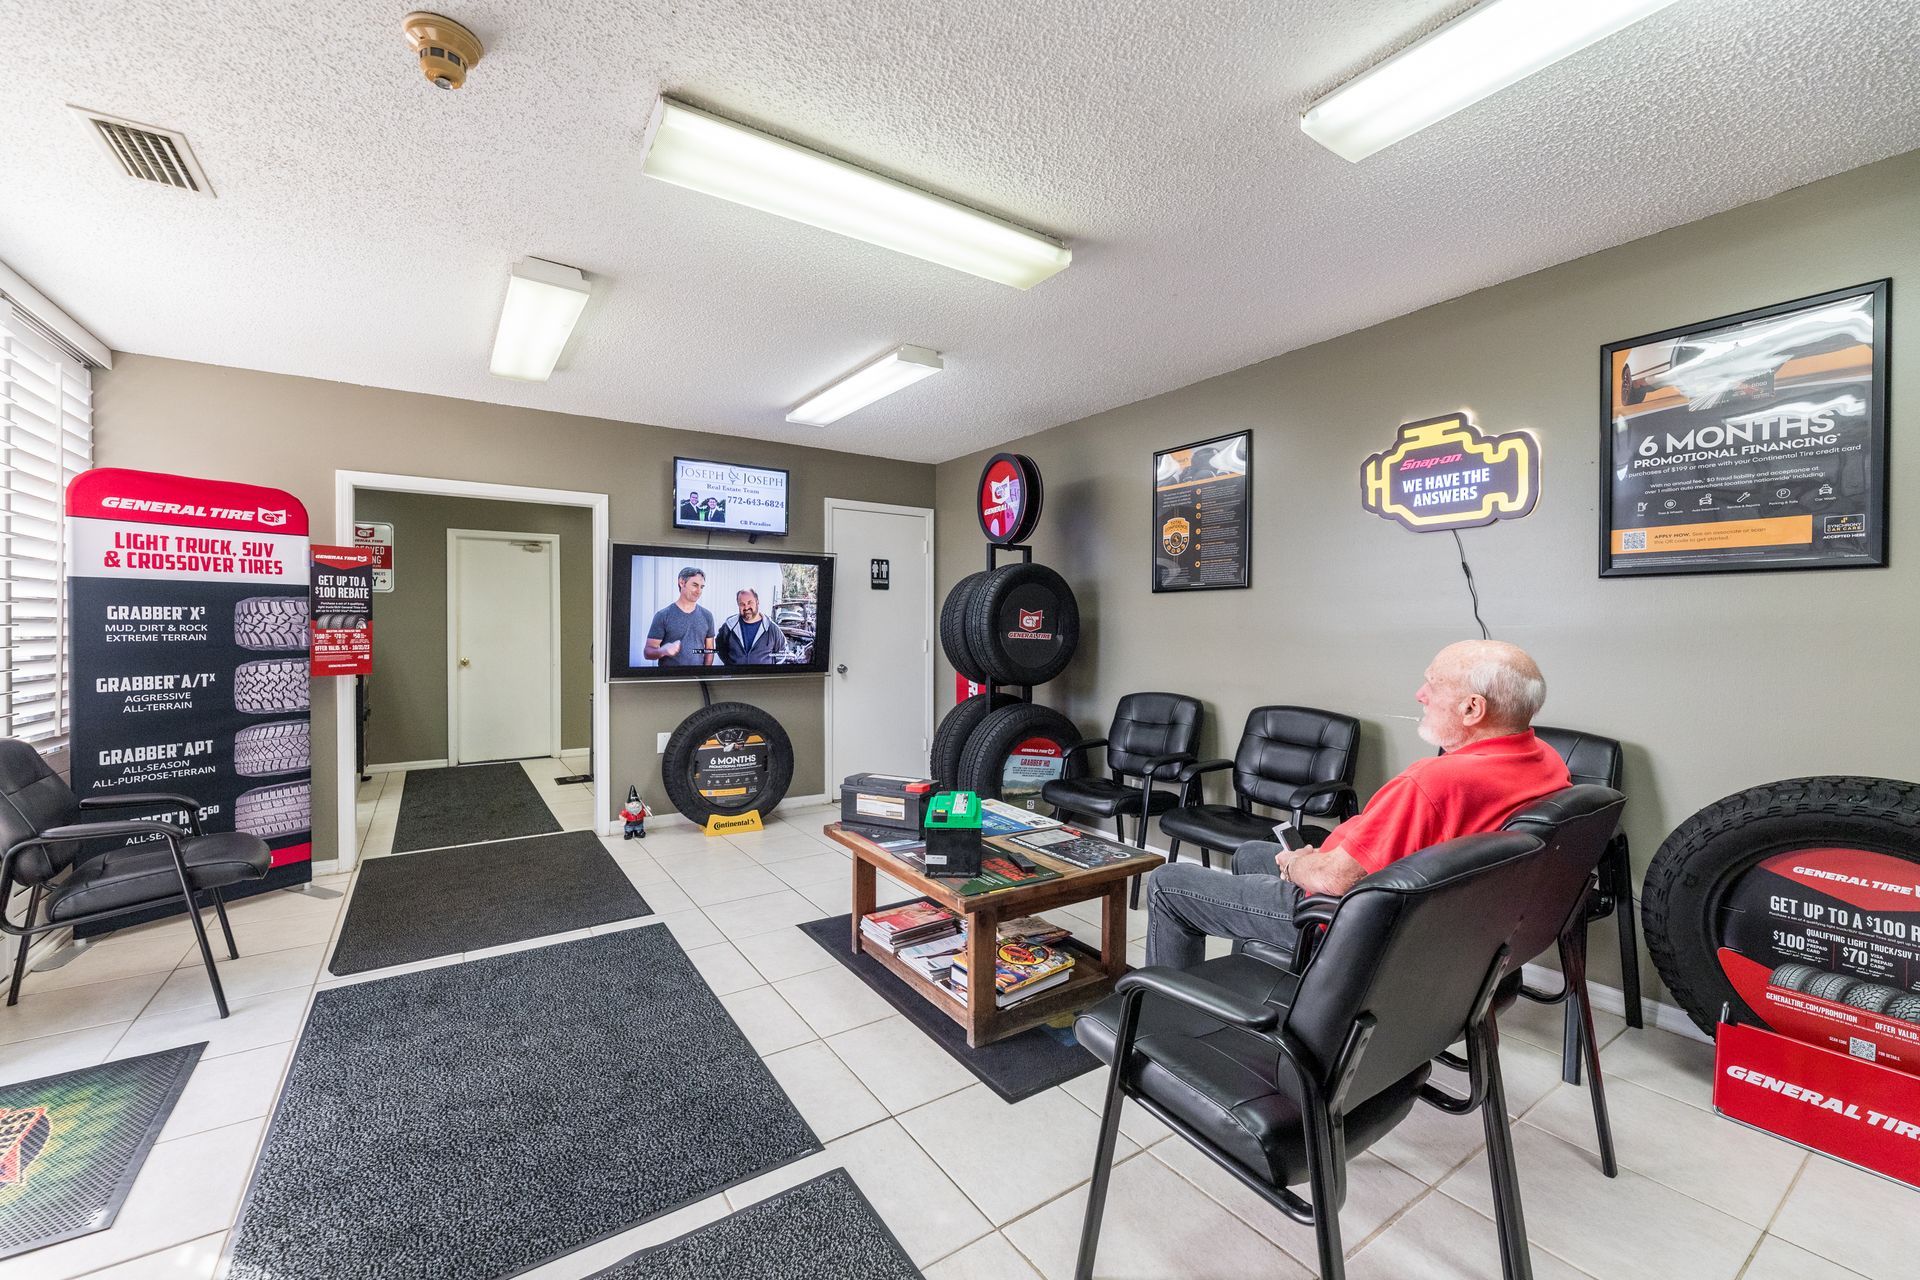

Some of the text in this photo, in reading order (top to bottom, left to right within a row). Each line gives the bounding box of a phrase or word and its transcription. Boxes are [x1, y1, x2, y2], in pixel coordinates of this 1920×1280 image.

[1638, 409, 1835, 457] 6 MONTHS
[1400, 453, 1462, 471] Snap-on
[1628, 468, 1662, 479] purchases
[1662, 466, 1670, 474] of
[1671, 465, 1688, 473] $199
[1697, 462, 1716, 470] more
[1717, 459, 1733, 467] with
[1734, 457, 1751, 467] your
[1752, 452, 1798, 463] Continental
[1799, 450, 1814, 458] Tire
[1815, 446, 1840, 456] credit
[1841, 443, 1862, 453] card
[1634, 447, 1737, 469] PROMOTIONAL
[681, 466, 724, 480] JOSEPH
[743, 473, 783, 487] JOSEPH
[1770, 466, 1811, 476] acceptance
[1402, 467, 1490, 493] WE HAVE THE
[1695, 482, 1724, 490] merchant
[1724, 479, 1752, 487] locations
[722, 485, 741, 493] Estate
[743, 487, 760, 495] Team
[1413, 485, 1478, 507] ANSWERS
[101, 496, 207, 517] GENERAL
[210, 507, 256, 521] TIRE
[727, 495, 784, 509] 772-643-6824
[114, 532, 274, 558] LIGHT TRUCK, SUV
[104, 551, 283, 575] & CROSSOVER TIRES
[318, 575, 334, 586] GET
[336, 576, 347, 586] UP
[349, 576, 359, 587] TO
[361, 576, 366, 587] A
[315, 586, 369, 599] $100 REBATE
[105, 624, 208, 633] MUD, DIRT & ROCK
[1008, 631, 1038, 639] GENERAL
[106, 634, 207, 642] EXTREME TERRAIN
[125, 692, 191, 703] AGGRESSIVE
[123, 701, 193, 713] ALL-TERRAIN
[184, 740, 214, 756] APT
[123, 760, 190, 774] ALL-SEASON
[710, 754, 756, 765] 6 MONTHS
[92, 766, 216, 788] ALL-PURPOSE-TERRAIN
[713, 818, 750, 830] Continental
[1792, 866, 1913, 895] GENERAL TIRE
[1770, 895, 1798, 914] GET
[1803, 902, 1824, 920] UP
[1827, 907, 1848, 926] TO
[1852, 913, 1863, 930] A
[1866, 915, 1906, 939] $100
[1773, 930, 1805, 950] $100
[1806, 928, 1846, 944] QUALIFYING
[1847, 937, 1868, 949] LIGHT
[1870, 942, 1913, 960] TRUCK/SUV
[1806, 943, 1828, 952] PREPAID
[1806, 947, 1821, 955] CARD
[1842, 946, 1868, 966] $70
[1869, 963, 1885, 971] CARD
[1870, 958, 1894, 967] PREPAID
[1765, 992, 1858, 1024] GENERALTIRE.COM/PROMOTION
[1875, 1022, 1919, 1041] OFFER VALID:
[1726, 1065, 1920, 1142] GENERAL TIR
